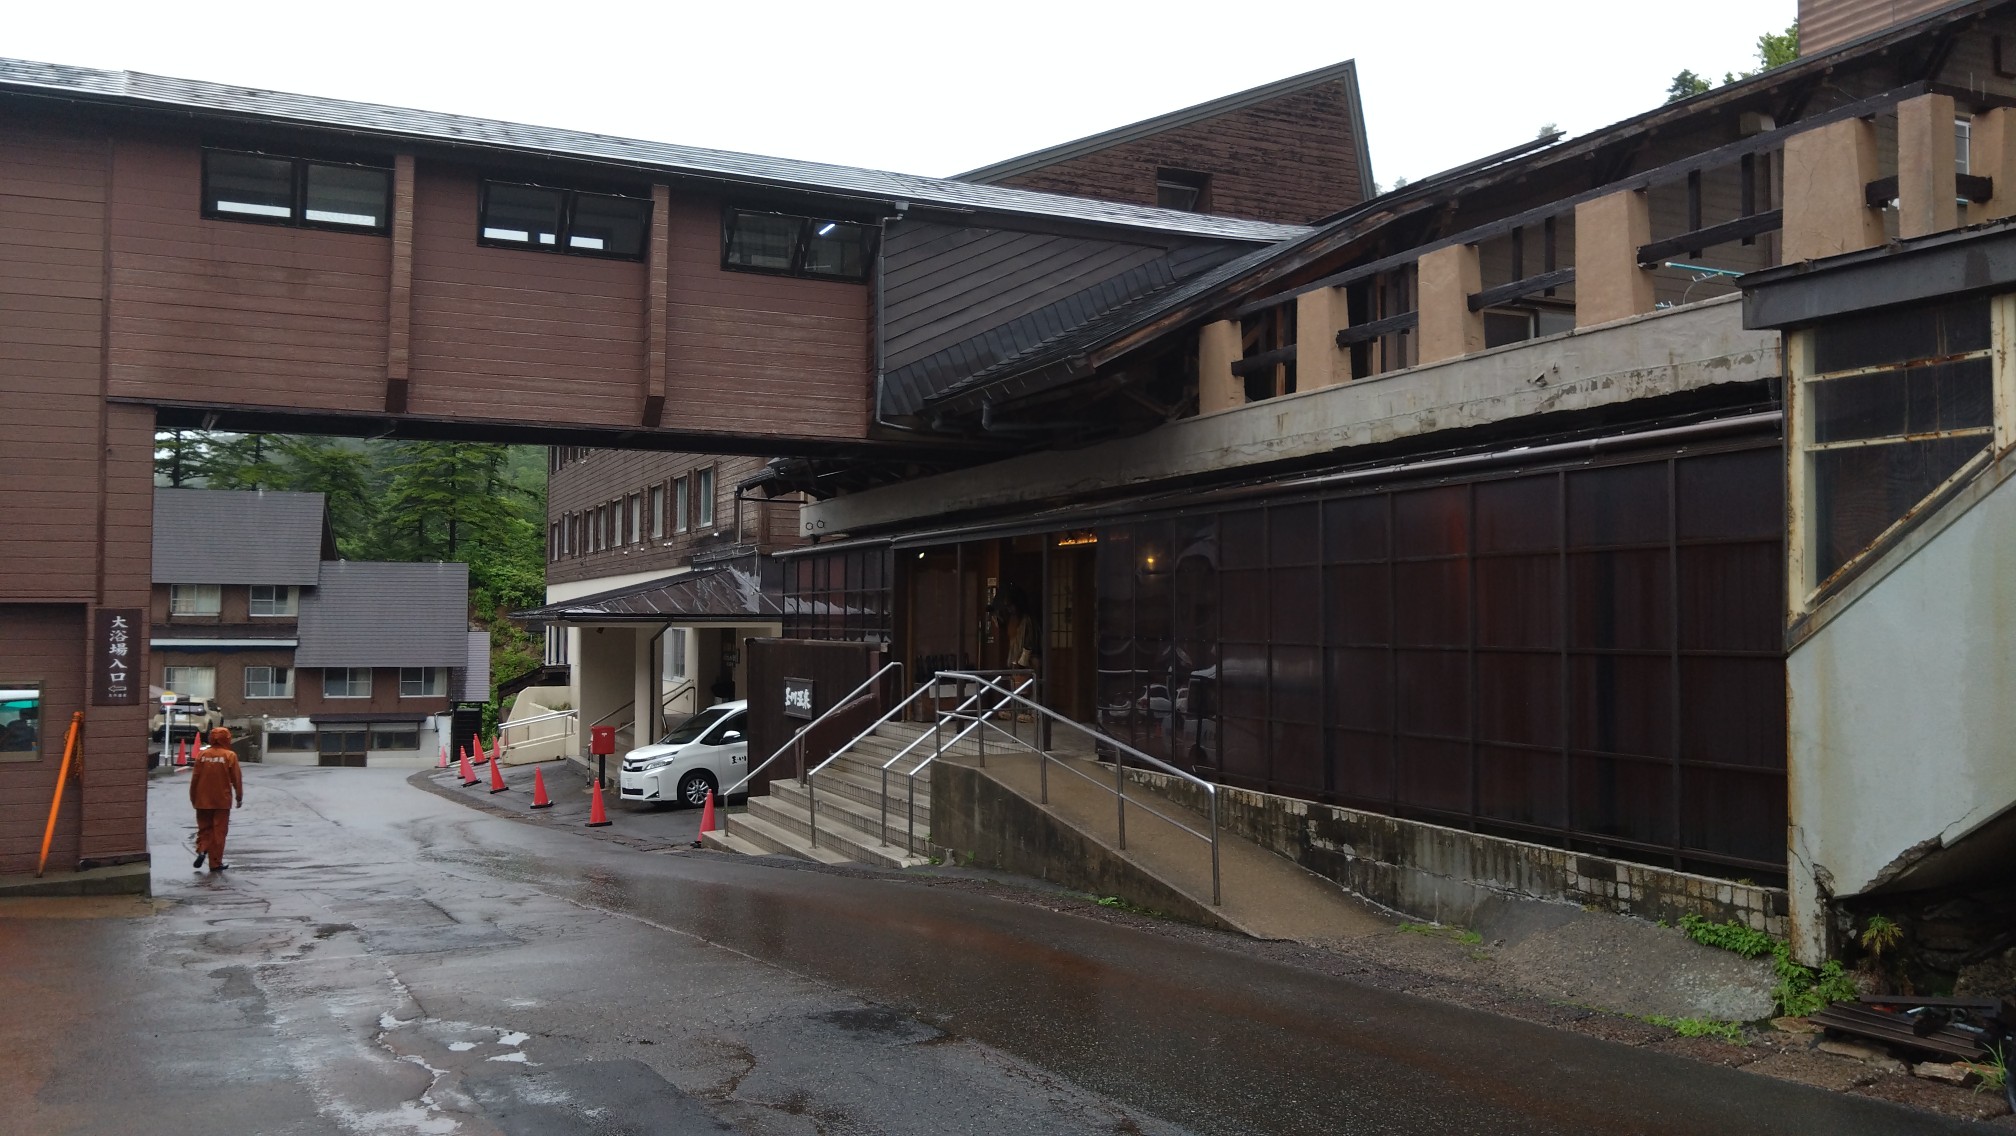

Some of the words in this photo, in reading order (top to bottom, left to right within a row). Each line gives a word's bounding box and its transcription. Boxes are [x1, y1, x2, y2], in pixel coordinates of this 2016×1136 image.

[108, 615, 129, 682] 大浴場入口
